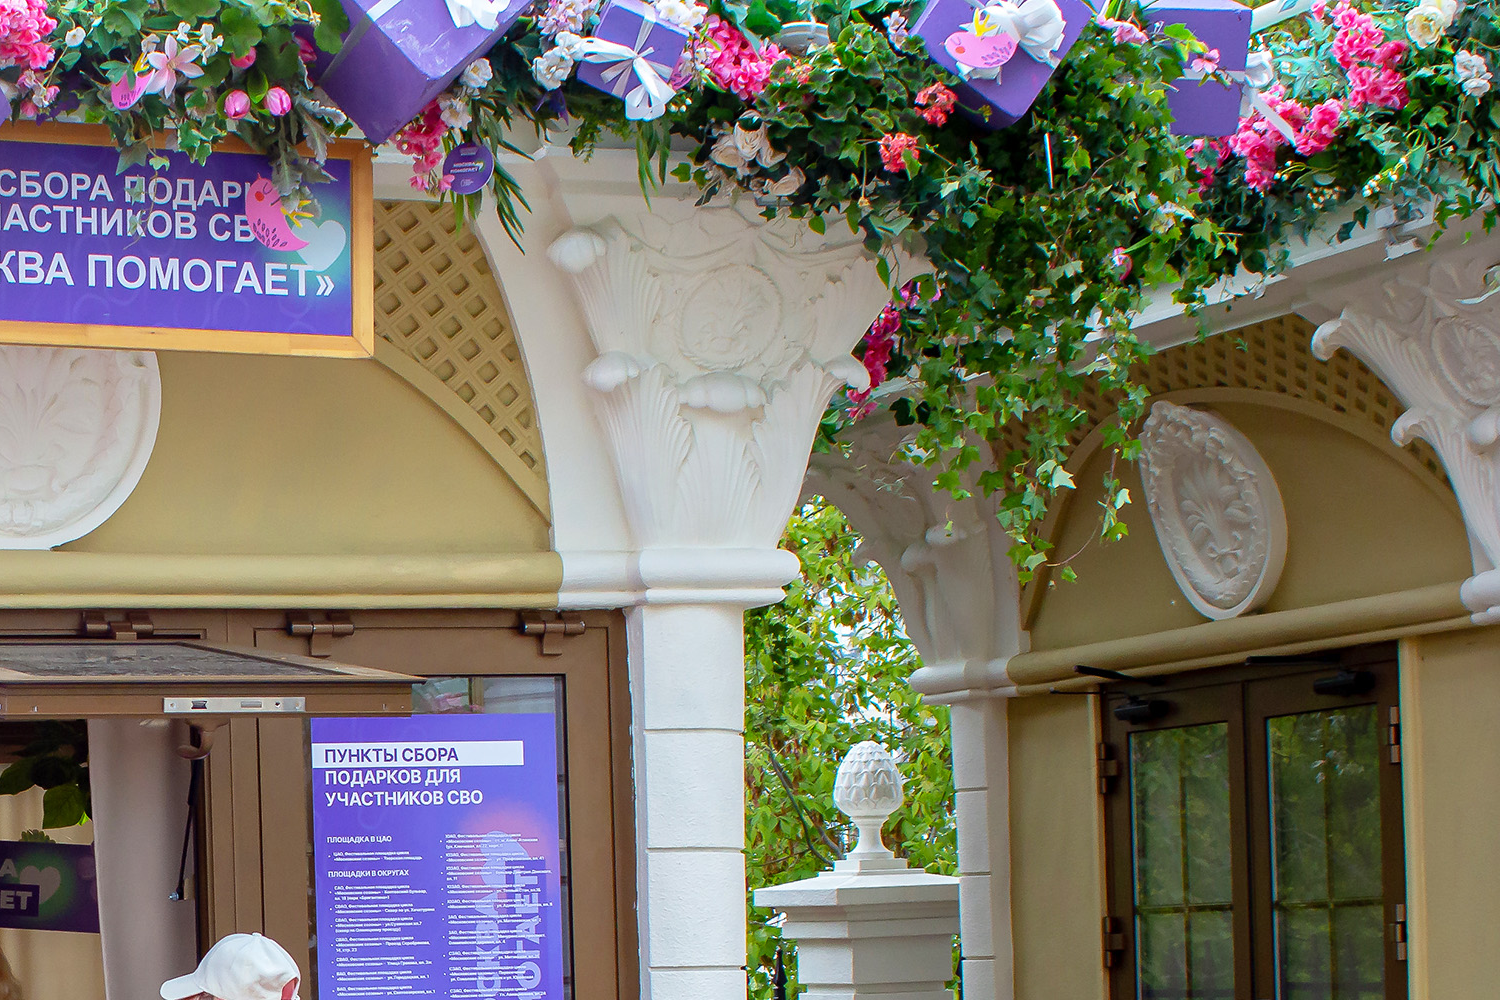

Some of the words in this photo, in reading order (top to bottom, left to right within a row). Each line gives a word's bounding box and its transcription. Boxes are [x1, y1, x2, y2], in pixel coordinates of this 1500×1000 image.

[124, 176, 251, 212] ПОДАР
[209, 213, 257, 242] СВ
[87, 254, 335, 298] ПОМОГАЕТ»
[324, 748, 398, 763] ПУНКТЫ
[401, 747, 459, 762] СБОРА
[325, 770, 421, 788] ПОДАРКОВ
[425, 768, 461, 786] ДЛЯ
[325, 791, 444, 807] УЧАСТНИКОВ
[447, 789, 483, 805] СВО
[327, 836, 370, 844] ПЛОЩАДКА
[376, 835, 392, 843] ЦАО
[328, 870, 370, 878] ПЛОЩАДКИ
